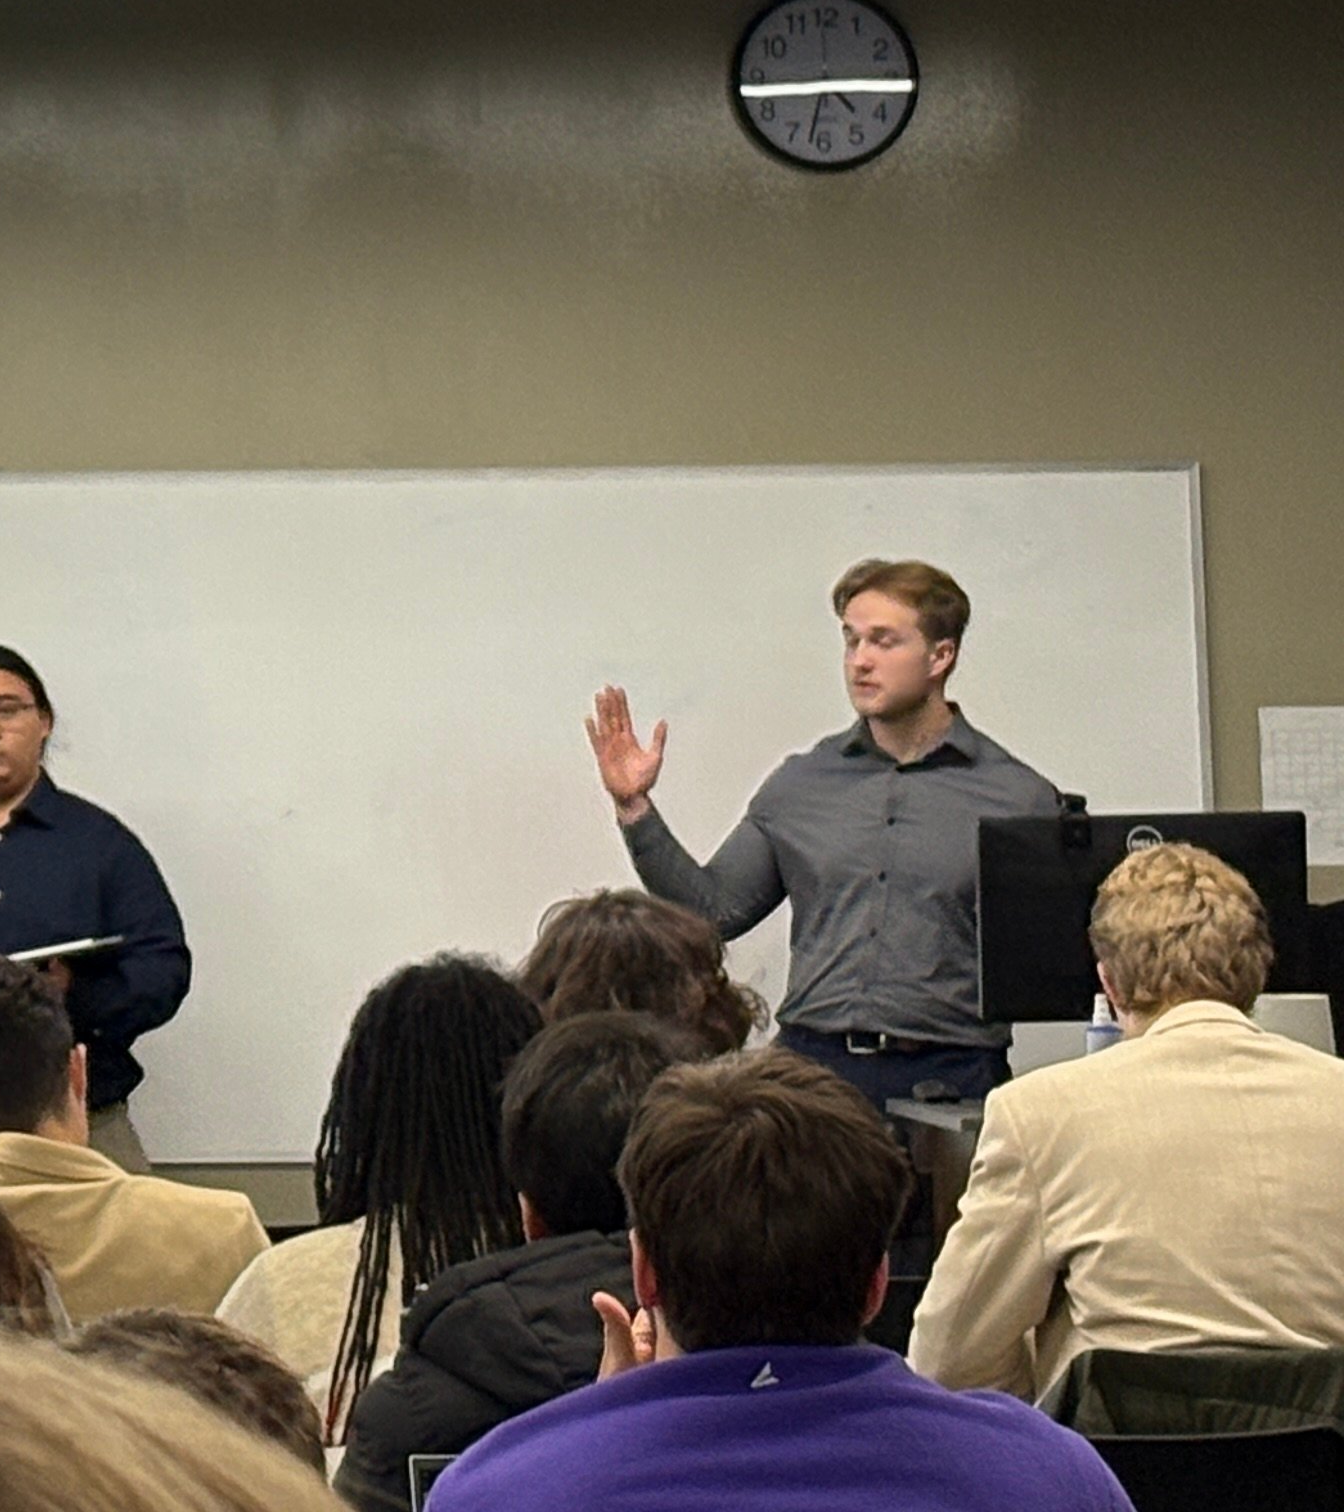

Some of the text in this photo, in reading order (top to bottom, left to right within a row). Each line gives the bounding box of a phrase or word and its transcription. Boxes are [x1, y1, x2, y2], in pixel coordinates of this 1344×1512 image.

[787, 13, 806, 35] 11
[814, 7, 838, 28] 12
[852, 16, 861, 34] 1
[763, 35, 787, 59] 10
[872, 38, 889, 61] 2
[761, 99, 775, 122] 8
[873, 101, 888, 123] 4
[785, 121, 801, 144] 7
[816, 130, 832, 153] 6
[849, 124, 864, 145] 5
